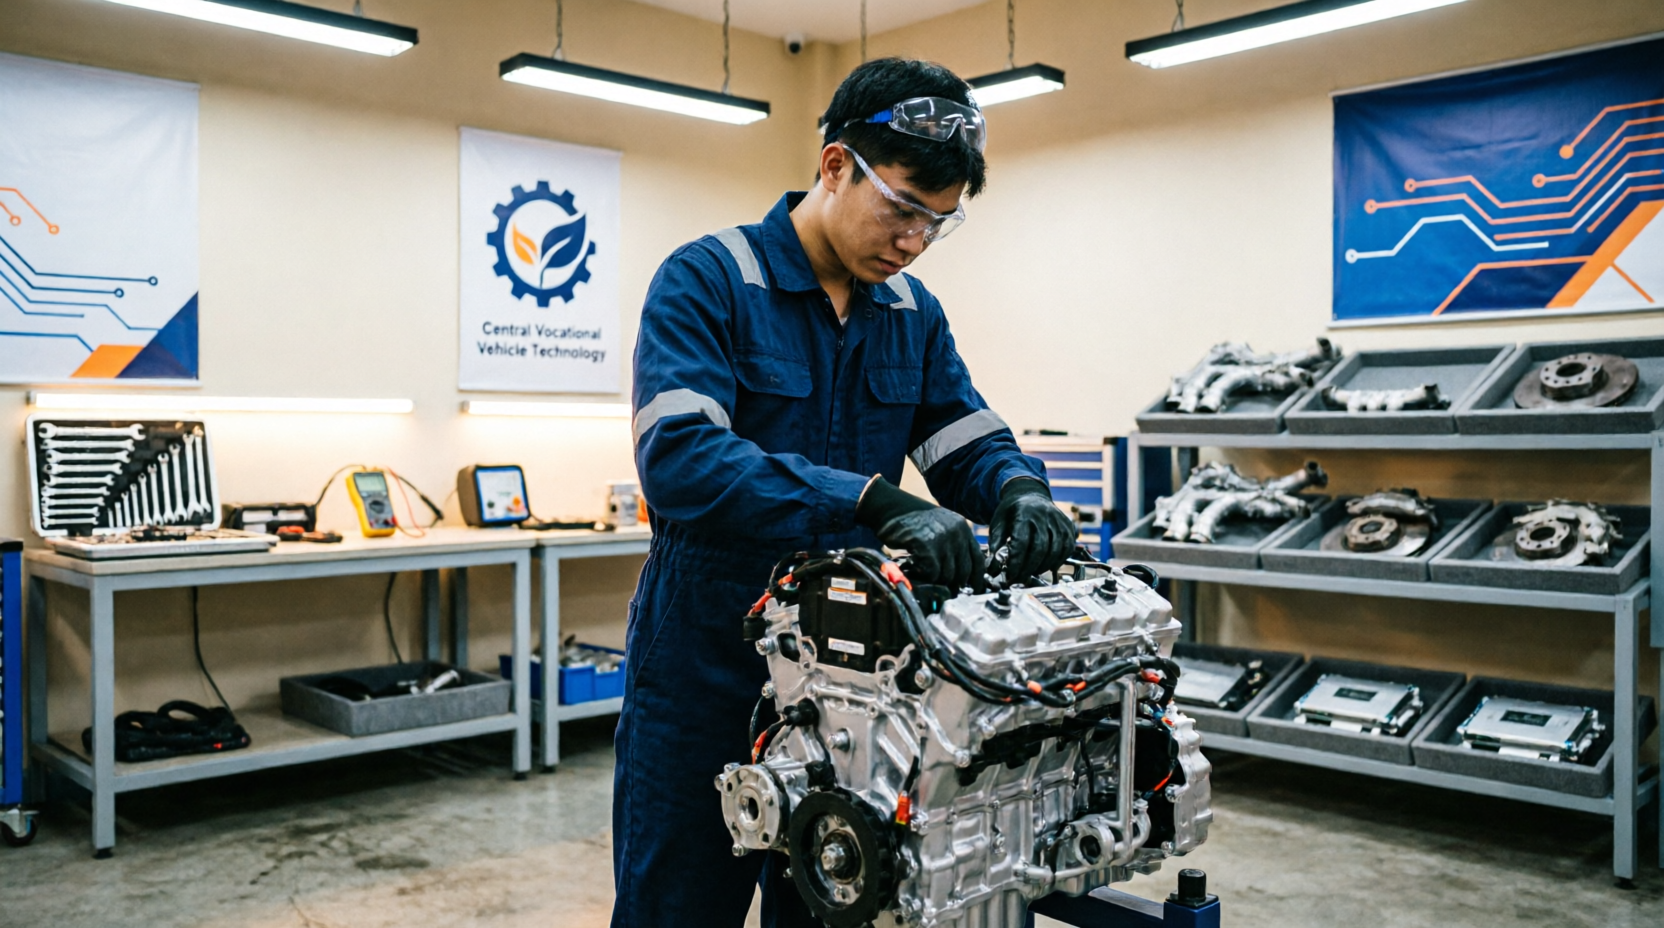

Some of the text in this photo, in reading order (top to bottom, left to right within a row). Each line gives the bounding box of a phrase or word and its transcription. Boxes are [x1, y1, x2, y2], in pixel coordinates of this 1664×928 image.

[482, 321, 602, 339] Central Vocational
[477, 341, 606, 362] Vehicle Technology
